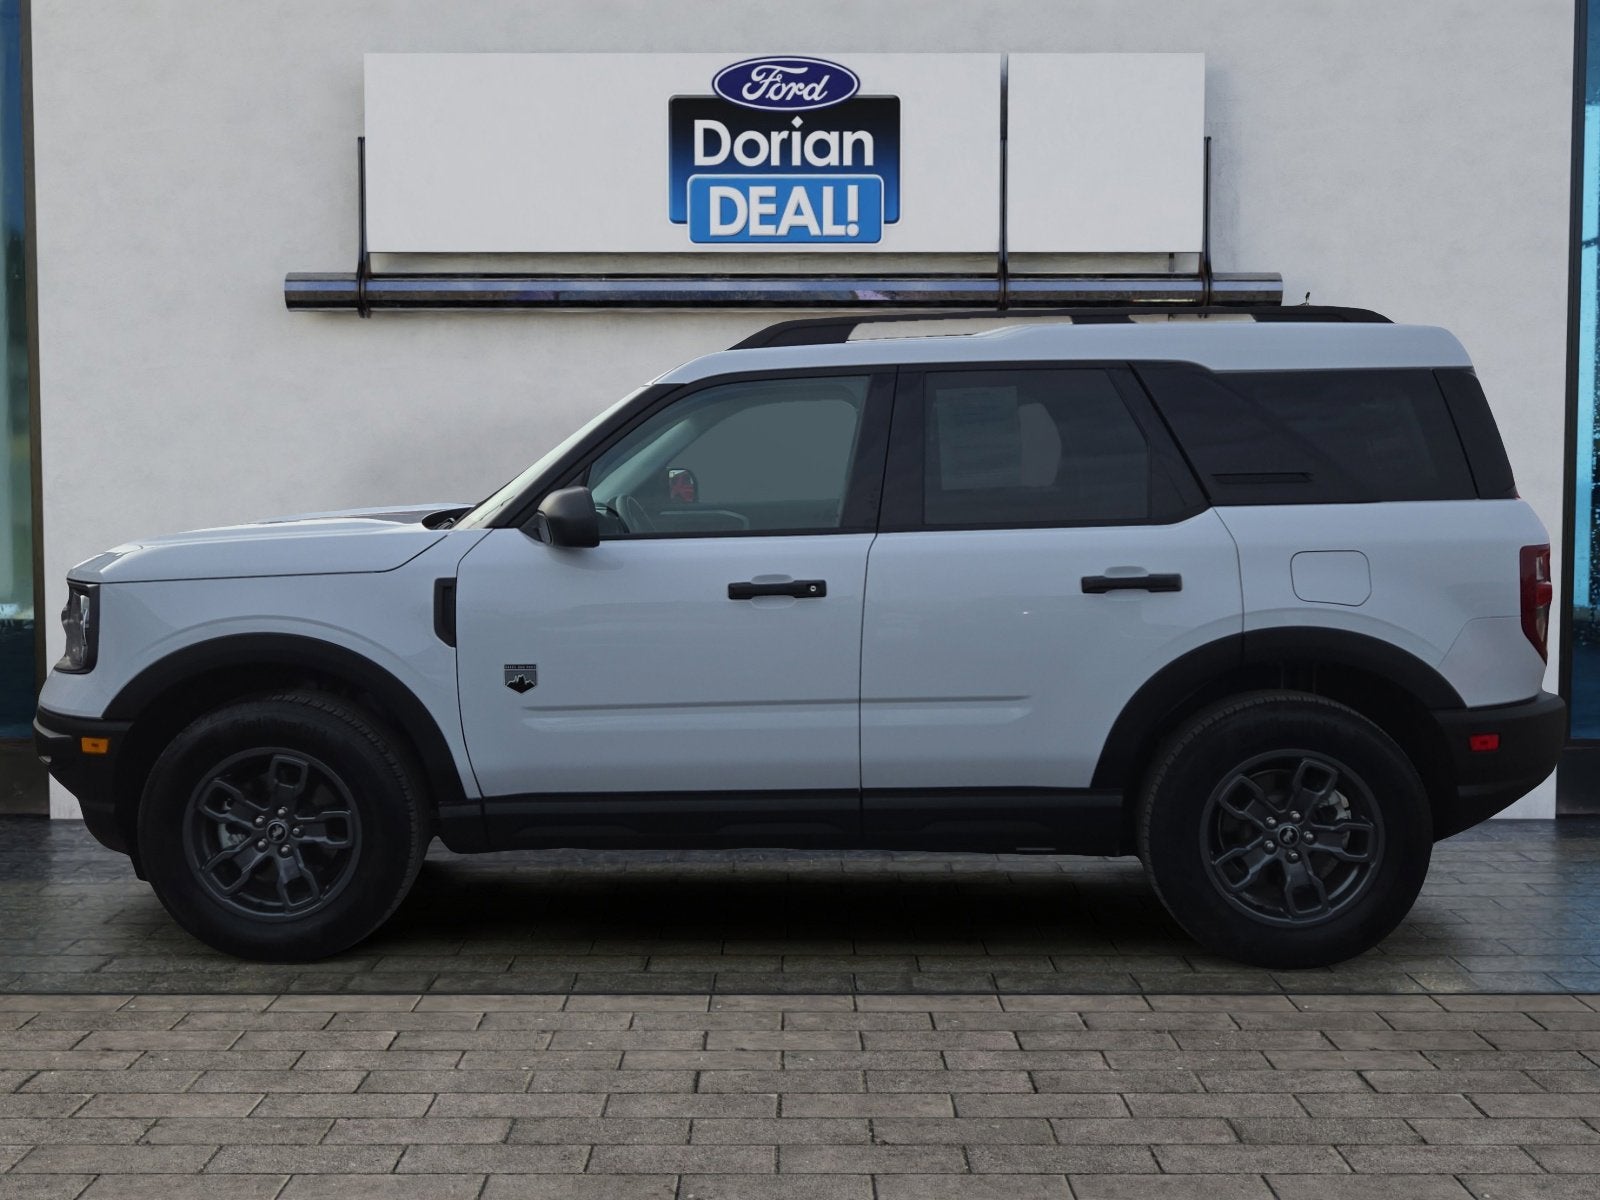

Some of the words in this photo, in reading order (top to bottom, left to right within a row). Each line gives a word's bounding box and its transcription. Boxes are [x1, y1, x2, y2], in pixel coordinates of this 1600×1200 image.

[742, 64, 831, 101] Ford
[694, 116, 874, 167] Dorian
[709, 185, 860, 237] DEAL!
